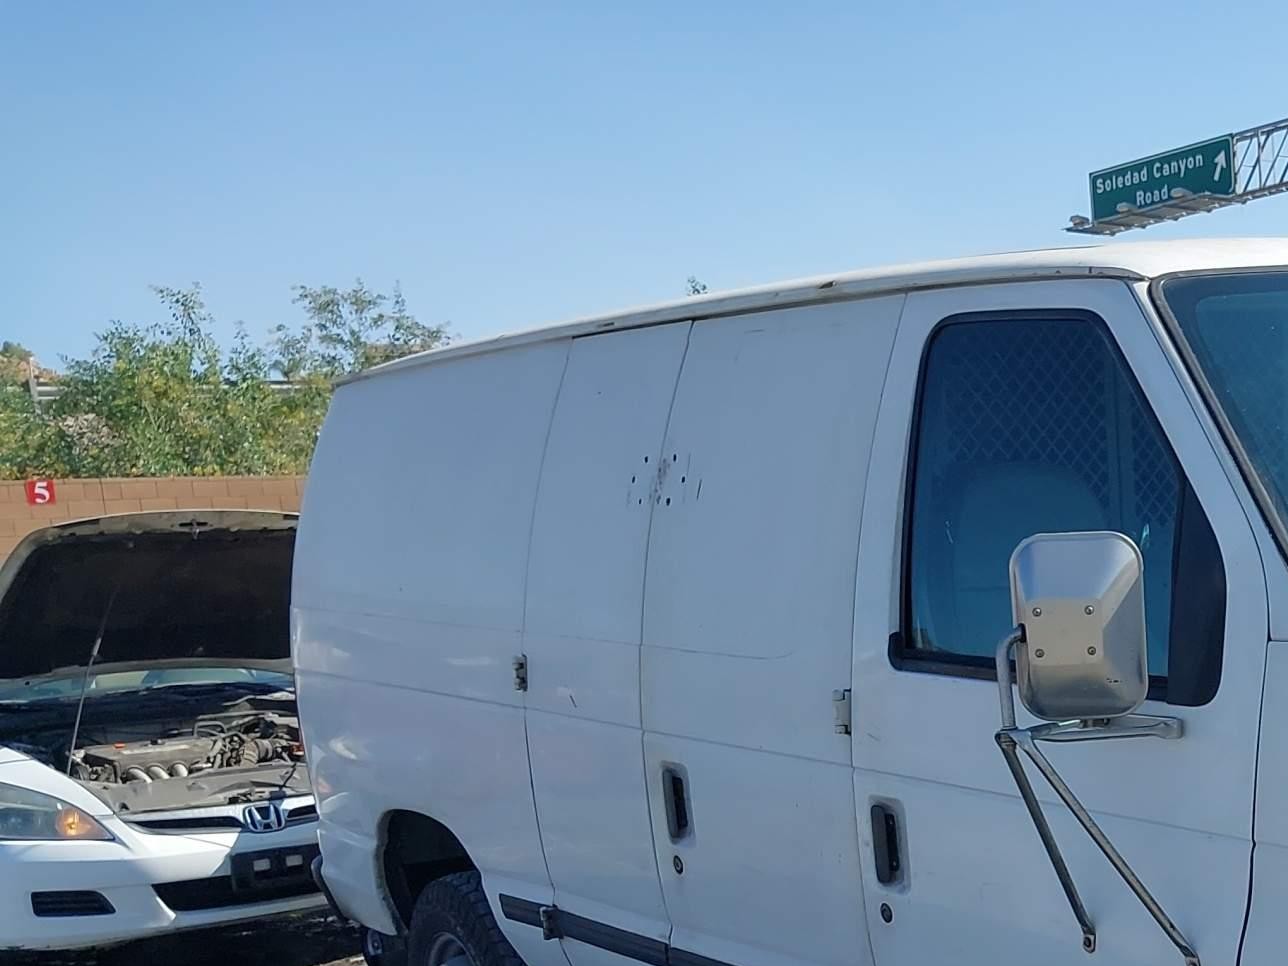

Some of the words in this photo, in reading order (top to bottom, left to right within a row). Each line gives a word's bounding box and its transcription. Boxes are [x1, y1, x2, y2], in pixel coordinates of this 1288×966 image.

[1096, 166, 1148, 193] Soledad
[1153, 153, 1204, 179] Canyon
[1136, 184, 1169, 207] Road
[34, 481, 50, 504] 5
